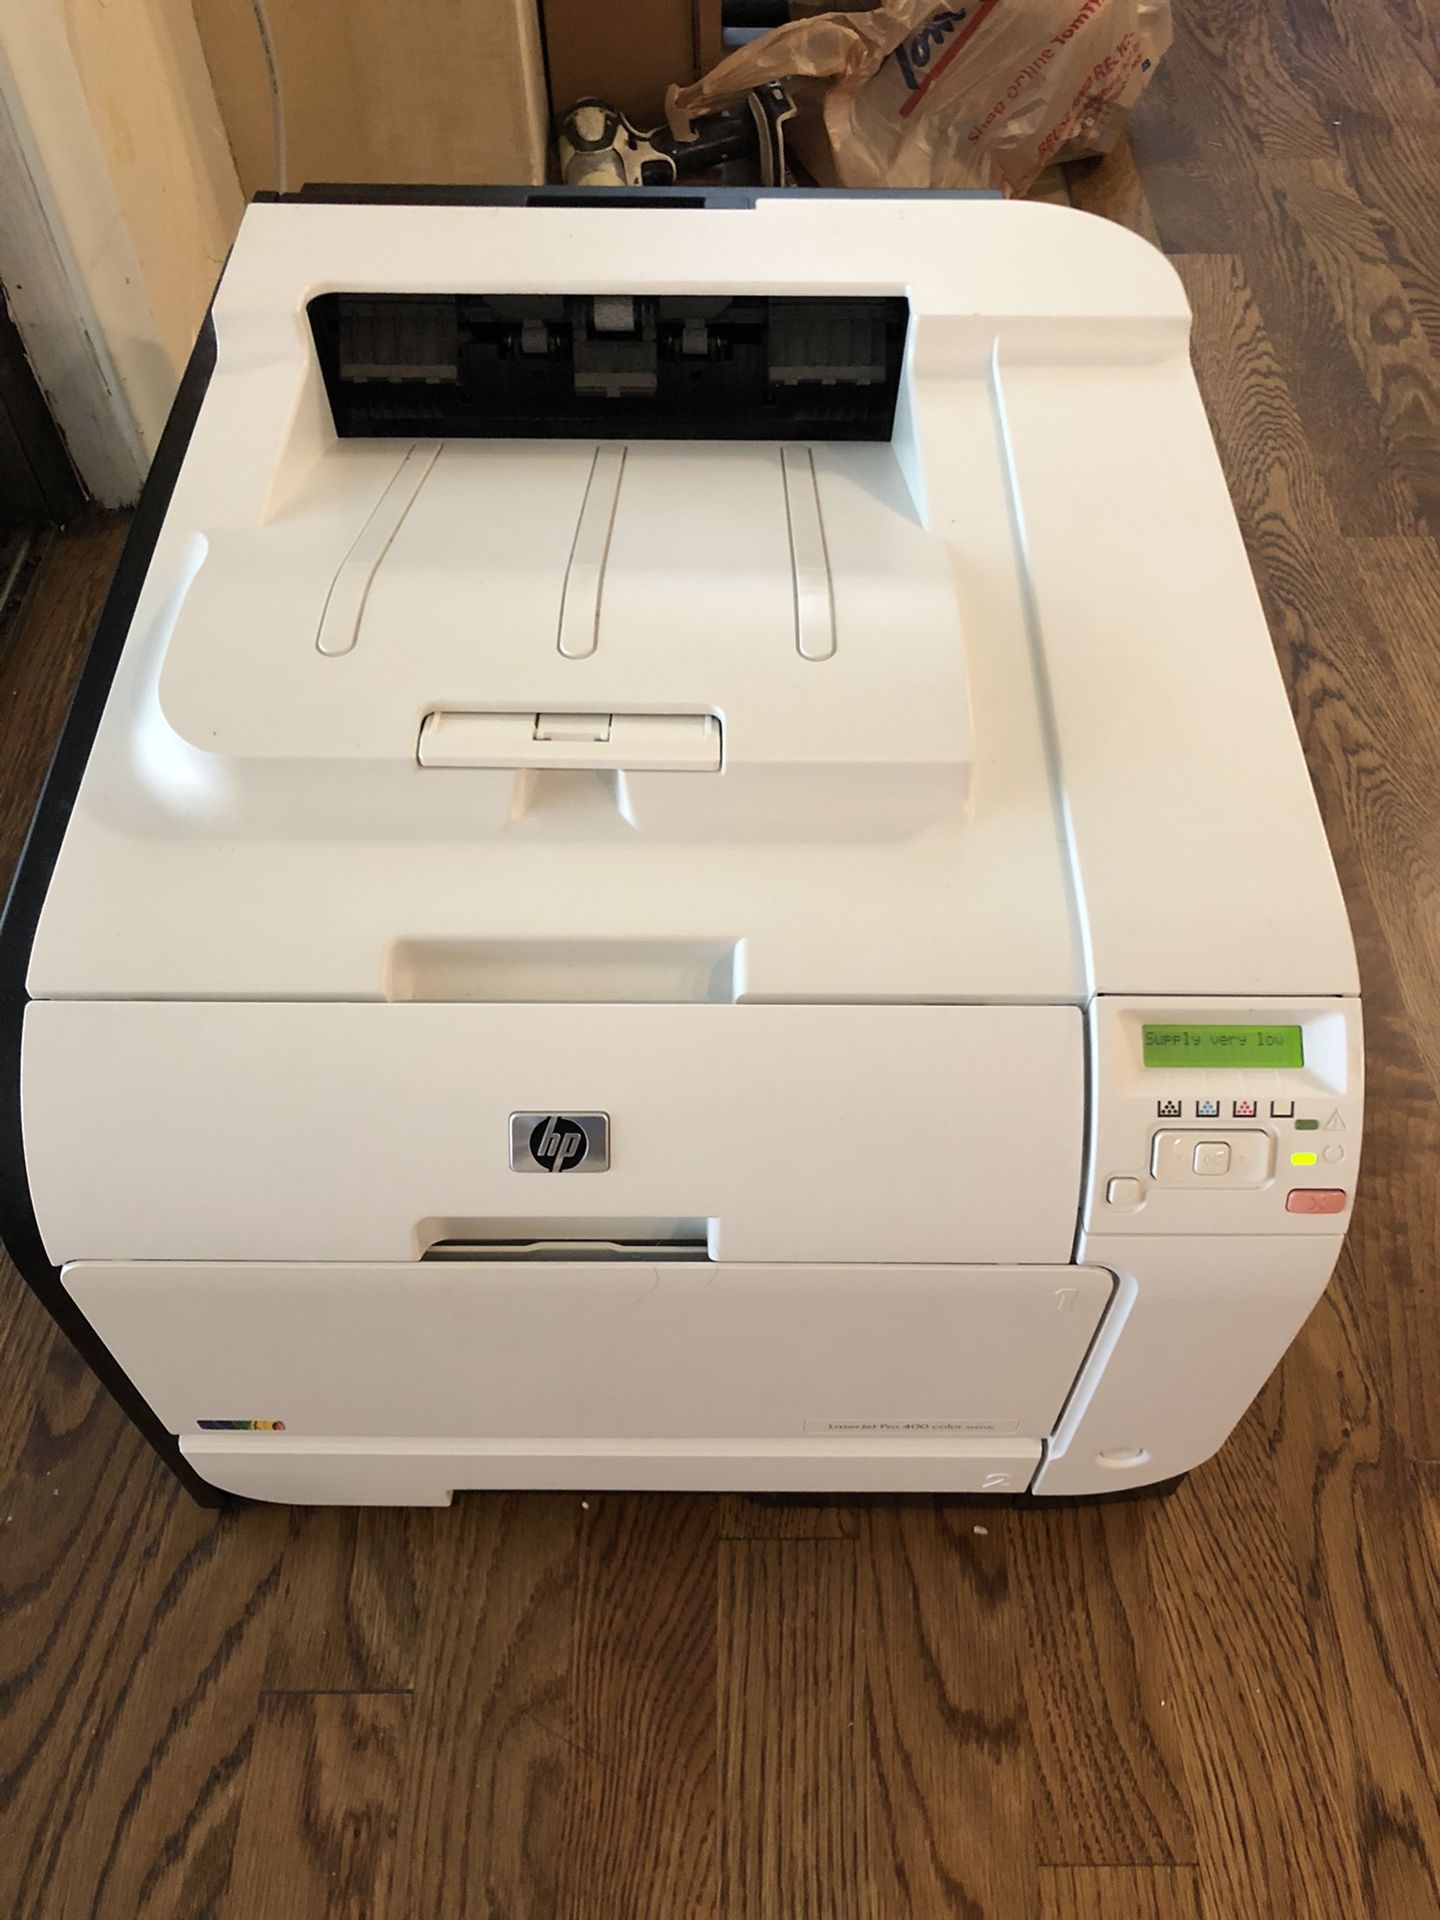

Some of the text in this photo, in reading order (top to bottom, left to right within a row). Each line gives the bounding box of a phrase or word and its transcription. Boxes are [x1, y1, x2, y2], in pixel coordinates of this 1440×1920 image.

[1145, 1031, 1285, 1046] Supply very low
[537, 1115, 582, 1173] hp
[828, 1423, 877, 1431] LaserJet
